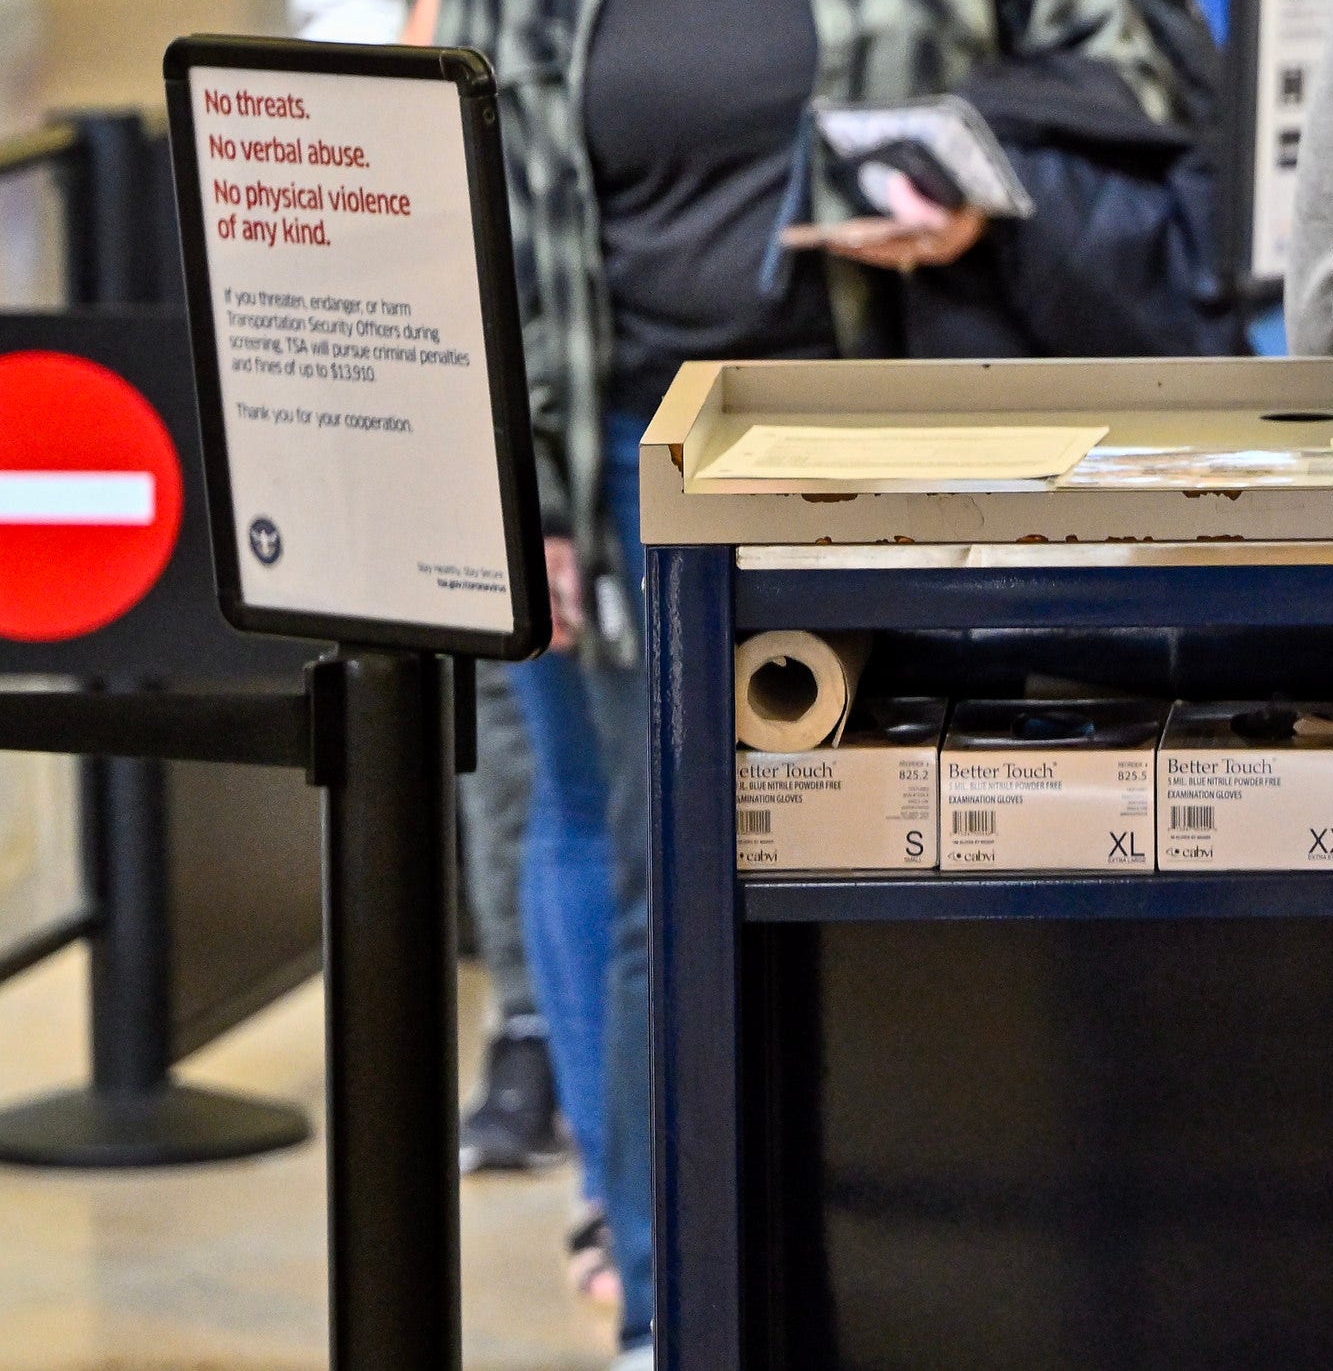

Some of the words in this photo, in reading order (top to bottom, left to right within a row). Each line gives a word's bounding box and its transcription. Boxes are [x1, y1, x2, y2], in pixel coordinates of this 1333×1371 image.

[205, 90, 231, 115] No
[236, 90, 310, 119] threats.
[209, 134, 236, 160] No
[240, 136, 302, 164] verbal
[308, 139, 370, 168] abuse.
[214, 179, 240, 205] No
[246, 180, 323, 213] physical
[328, 185, 411, 216] violence
[218, 213, 236, 239] of
[242, 220, 277, 247] any
[282, 217, 331, 246] kind.
[234, 292, 256, 307] you
[259, 290, 307, 310] threaten,
[310, 295, 363, 316] endanger,
[366, 300, 377, 313] or
[381, 299, 411, 316] harm
[227, 310, 307, 333] Transportation
[308, 315, 353, 335] Security
[356, 319, 400, 339] Officers
[403, 322, 440, 344] during
[286, 336, 308, 354] TSA
[311, 340, 329, 356] will
[332, 343, 370, 360] pursue
[373, 344, 416, 362] criminal
[420, 347, 470, 367] penalties
[231, 356, 251, 372] and
[254, 357, 282, 375] fines
[284, 358, 296, 375] of
[298, 364, 314, 379] up
[316, 363, 328, 378] to
[237, 402, 270, 420] Thank
[274, 407, 294, 424] you
[296, 405, 312, 423] for
[316, 410, 342, 428] your
[737, 764, 779, 779] etter
[782, 761, 833, 778] Touch
[949, 763, 999, 779] Better
[1003, 762, 1053, 779] Touch
[1168, 758, 1218, 774] Better
[1222, 758, 1272, 774] Touch
[899, 770, 929, 780] 825.2
[1117, 771, 1148, 781] 825.5
[1189, 777, 1206, 786] BLUE
[1207, 777, 1233, 786] NITRILE
[1234, 777, 1264, 786] POWDER
[1265, 777, 1281, 786] FREE
[749, 780, 765, 789] BLUE
[768, 780, 793, 789] NITRILE
[795, 780, 824, 789] POWDER
[826, 780, 841, 789] FREE
[970, 781, 987, 790] BLUE
[989, 781, 1013, 790] NITRILE
[1015, 781, 1044, 790] POWDER
[1046, 781, 1062, 790] FREE
[736, 794, 775, 803] AMINATION
[777, 794, 802, 803] GLOVES
[949, 795, 996, 804] EXAMINATION
[997, 795, 1023, 804] GLOVES
[1168, 791, 1215, 799] EXAMINATION
[1216, 791, 1242, 799] GLOVES
[906, 830, 924, 857] S
[1109, 831, 1145, 857] XL
[1182, 846, 1213, 858] cabvi
[964, 849, 995, 862] cabvi
